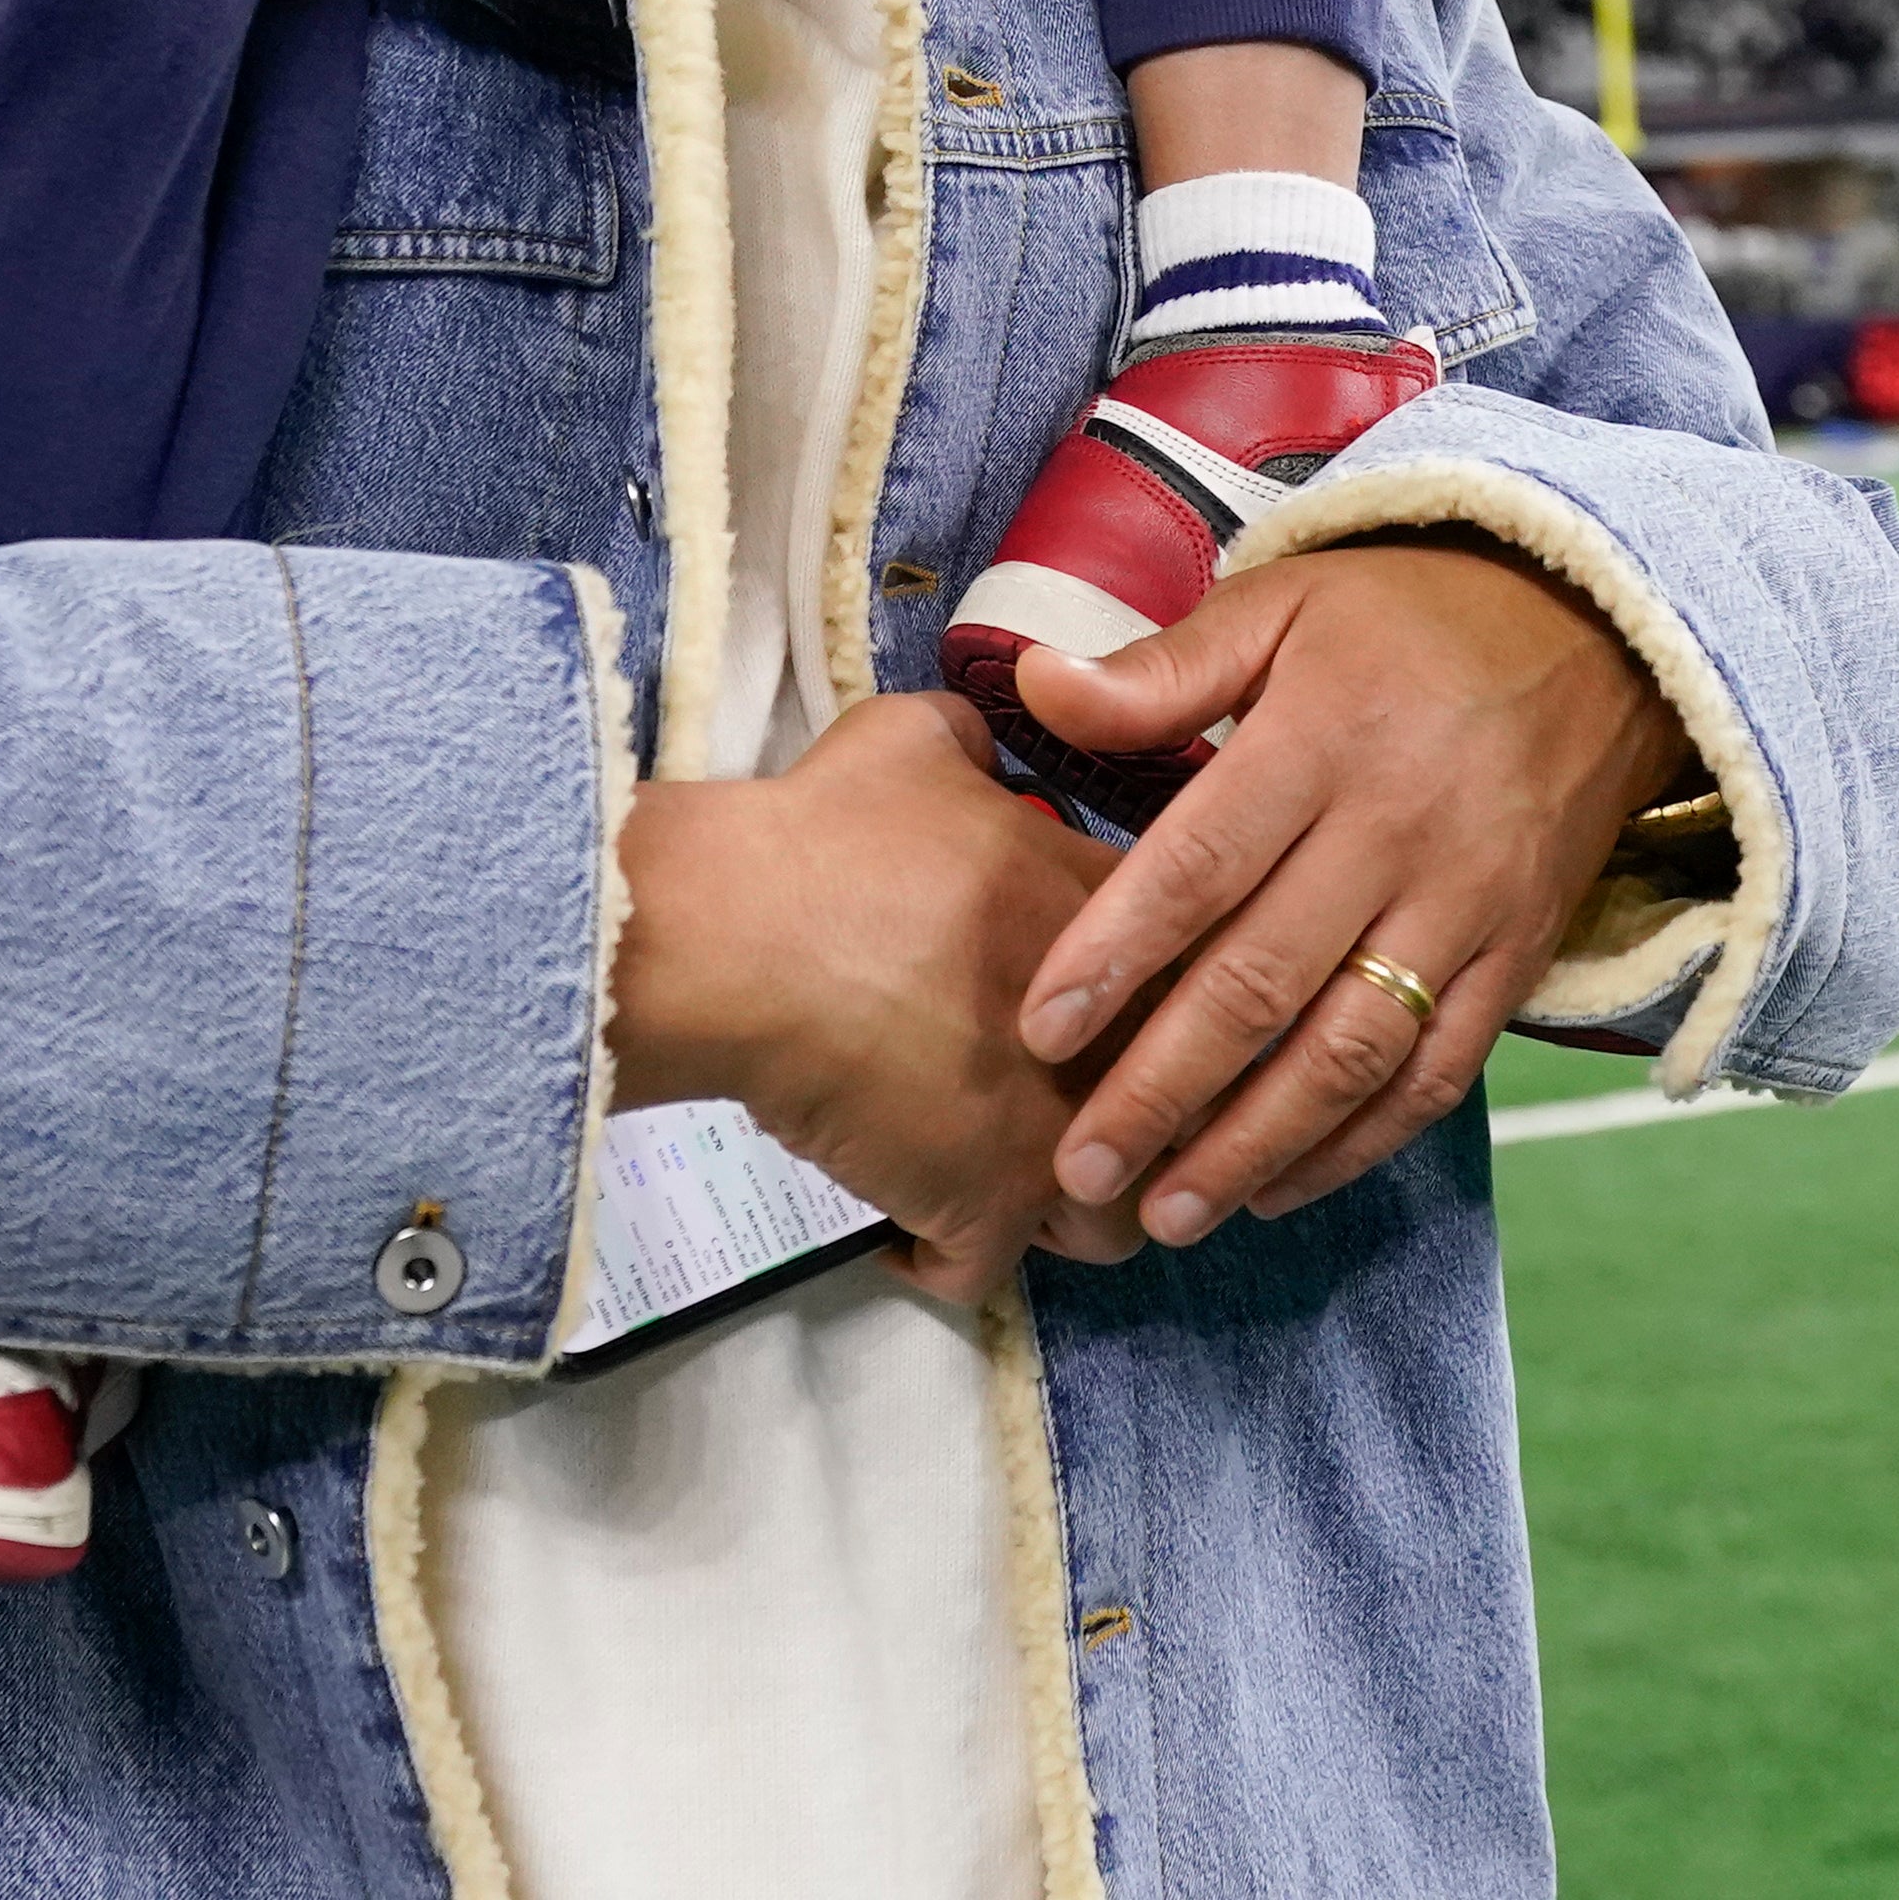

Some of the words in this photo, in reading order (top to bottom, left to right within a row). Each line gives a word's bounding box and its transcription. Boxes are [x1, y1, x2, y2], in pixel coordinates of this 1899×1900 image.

[705, 1124, 724, 1153] 15.70
[782, 1190, 812, 1243] McCaffrey
[830, 1194, 851, 1226] Smith
[743, 1208, 773, 1261] McKinnon
[668, 1250, 695, 1296] Johnson
[632, 1275, 655, 1312] Butker
[594, 1297, 616, 1331] Dallas
